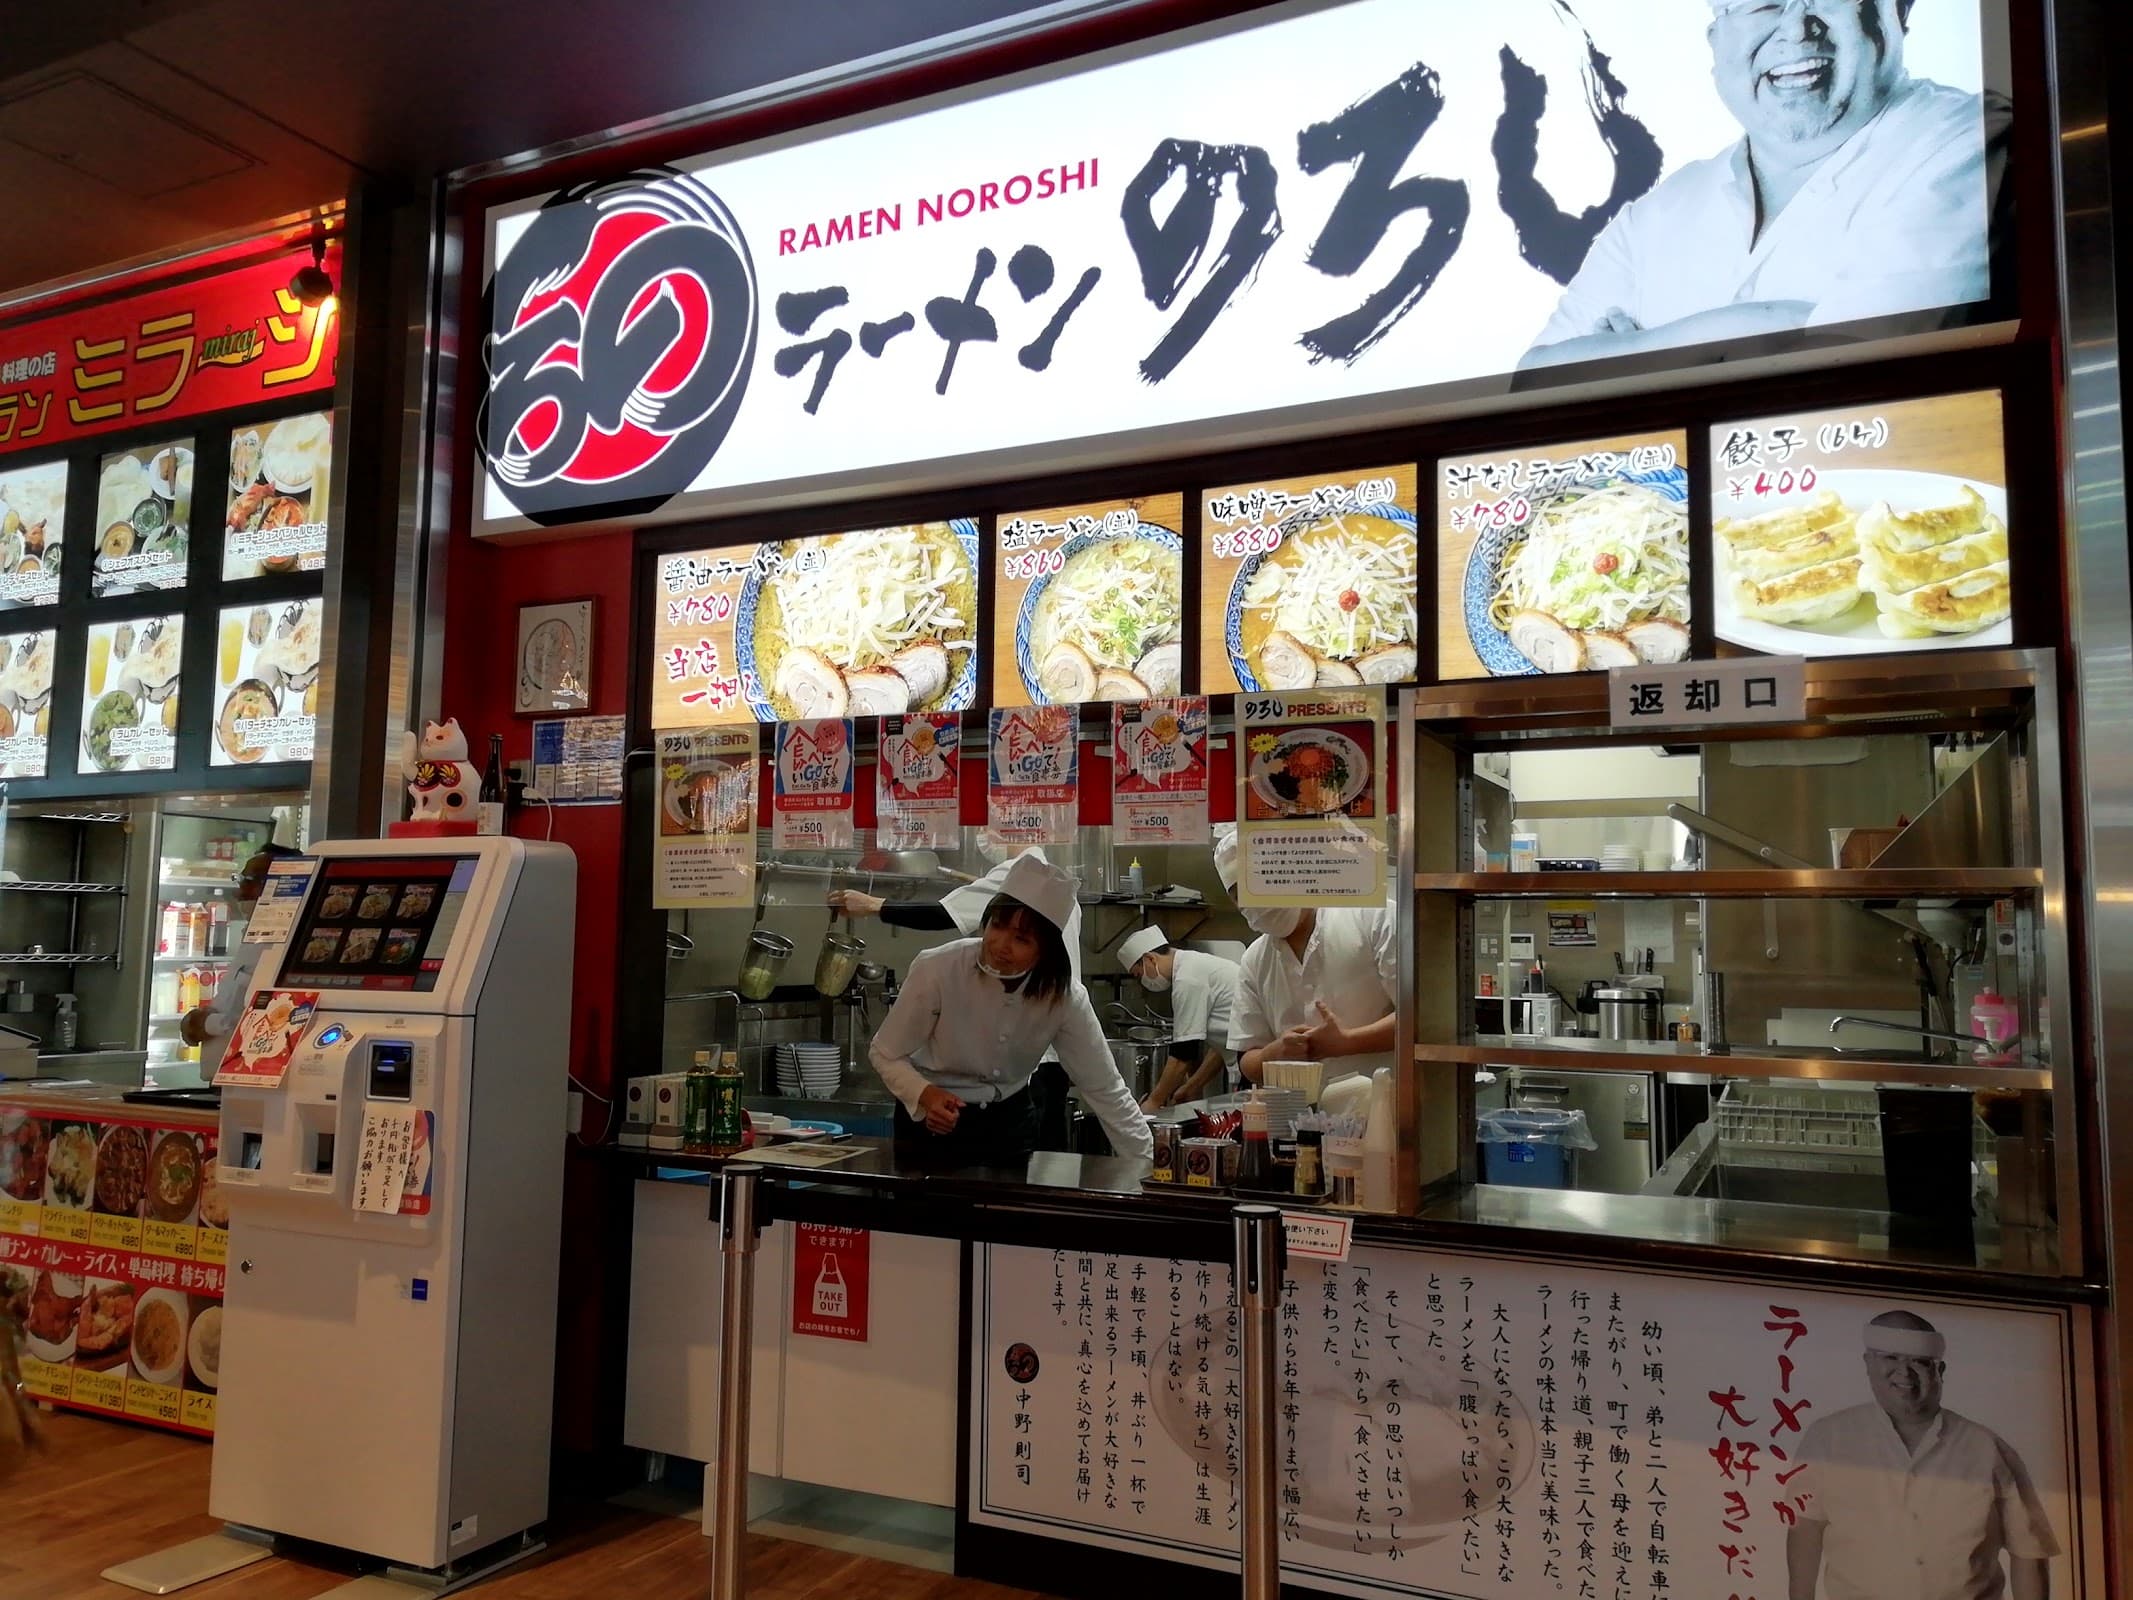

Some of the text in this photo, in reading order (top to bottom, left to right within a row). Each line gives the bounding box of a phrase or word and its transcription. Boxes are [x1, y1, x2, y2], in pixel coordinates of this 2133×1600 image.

[774, 0, 1664, 415] ラーメン のろし
[778, 157, 1100, 257] RAMEN NOROSHI
[202, 318, 261, 361] miraj
[1, 350, 56, 385] 料理の店
[1729, 468, 1818, 501] ¥400
[1453, 499, 1530, 528] ¥780
[1214, 528, 1280, 555] ¥880
[1007, 552, 1064, 578] ¥860
[668, 595, 731, 625] ¥780
[664, 640, 718, 679] 当店
[681, 673, 763, 709] 一押し
[1245, 696, 1366, 720] のろし PRESENTS
[1629, 675, 1778, 717] 返却口
[664, 733, 749, 752] のろし PRESENTS
[818, 1290, 844, 1302] TAKE
[820, 1301, 841, 1313] OUT
[1322, 1262, 1341, 1367] に変わった。
[1426, 1273, 1446, 1362] と思った。
[1076, 1249, 1094, 1505] 間と共に、真心を込めてお届け
[1763, 1304, 1813, 1527] ラーメンが
[1014, 1388, 1033, 1486] 中野則司
[1641, 1320, 1670, 1600] 幼い頃、弟と二人で自転車
[1708, 1385, 1760, 1600] 大好きだ
